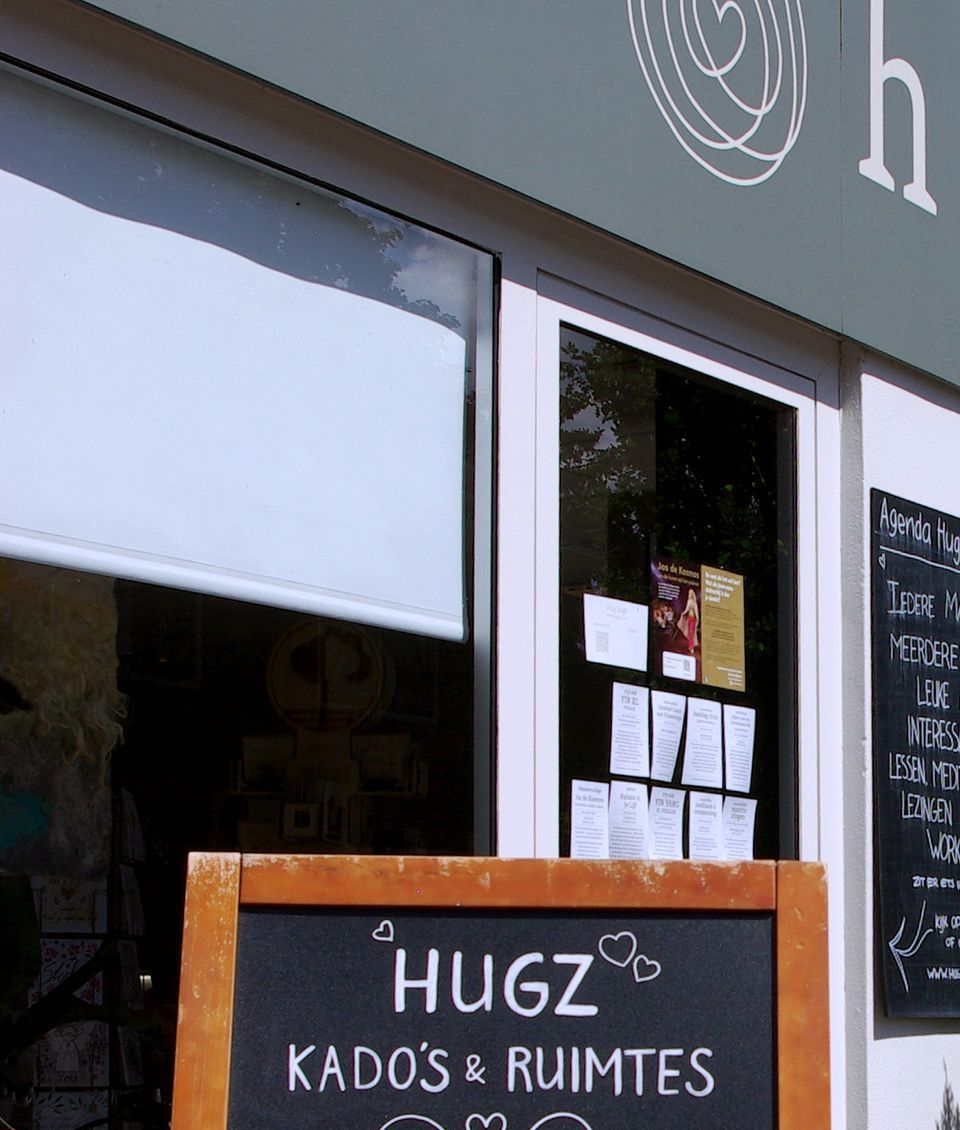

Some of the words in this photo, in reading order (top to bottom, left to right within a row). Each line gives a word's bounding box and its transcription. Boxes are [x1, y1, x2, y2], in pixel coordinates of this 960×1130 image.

[879, 497, 932, 545] Agenda
[887, 579, 935, 619] IEDERE
[890, 632, 959, 670] MEERDERE
[916, 675, 951, 710] LEUKE
[902, 790, 953, 826] LEZINGEN
[945, 936, 955, 948] OF
[395, 949, 599, 1017] HUGZ
[289, 1042, 450, 1093] KADO'S
[465, 1054, 486, 1085] &
[508, 1047, 715, 1097] RUIMTES
